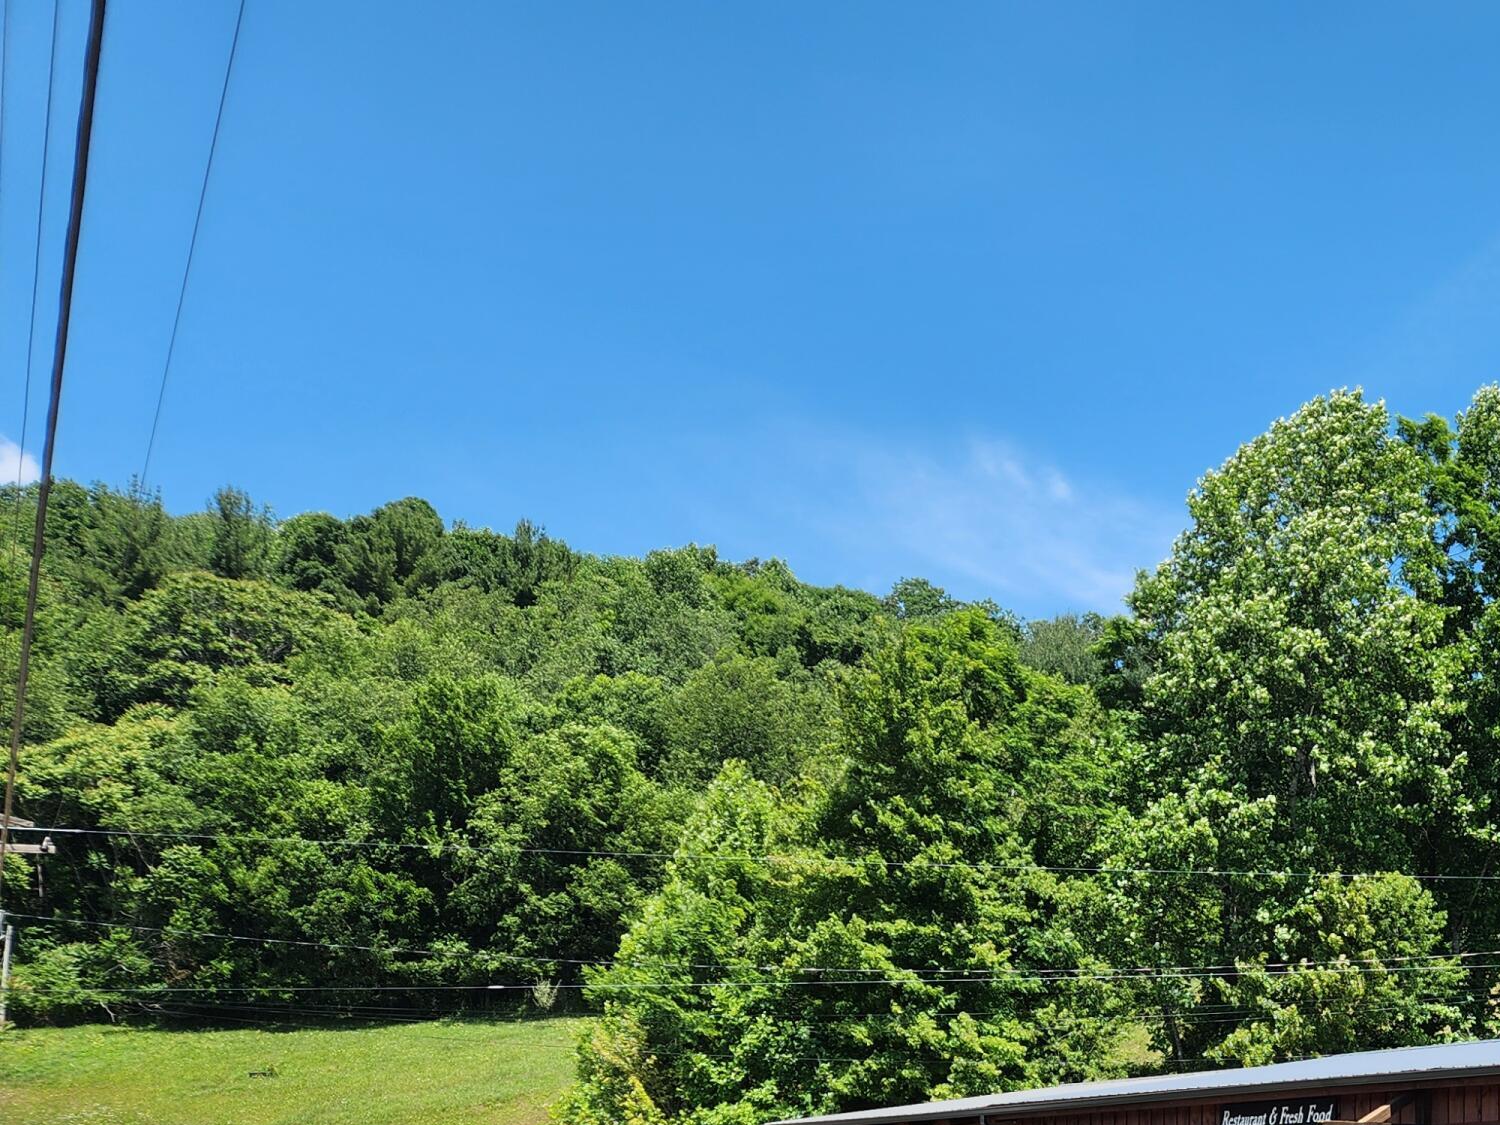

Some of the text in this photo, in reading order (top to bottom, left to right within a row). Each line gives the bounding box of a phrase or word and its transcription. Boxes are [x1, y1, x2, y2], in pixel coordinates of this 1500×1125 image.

[1269, 1106, 1278, 1125] &
[1279, 1105, 1304, 1125] Fresh
[1306, 1103, 1334, 1123] Food
